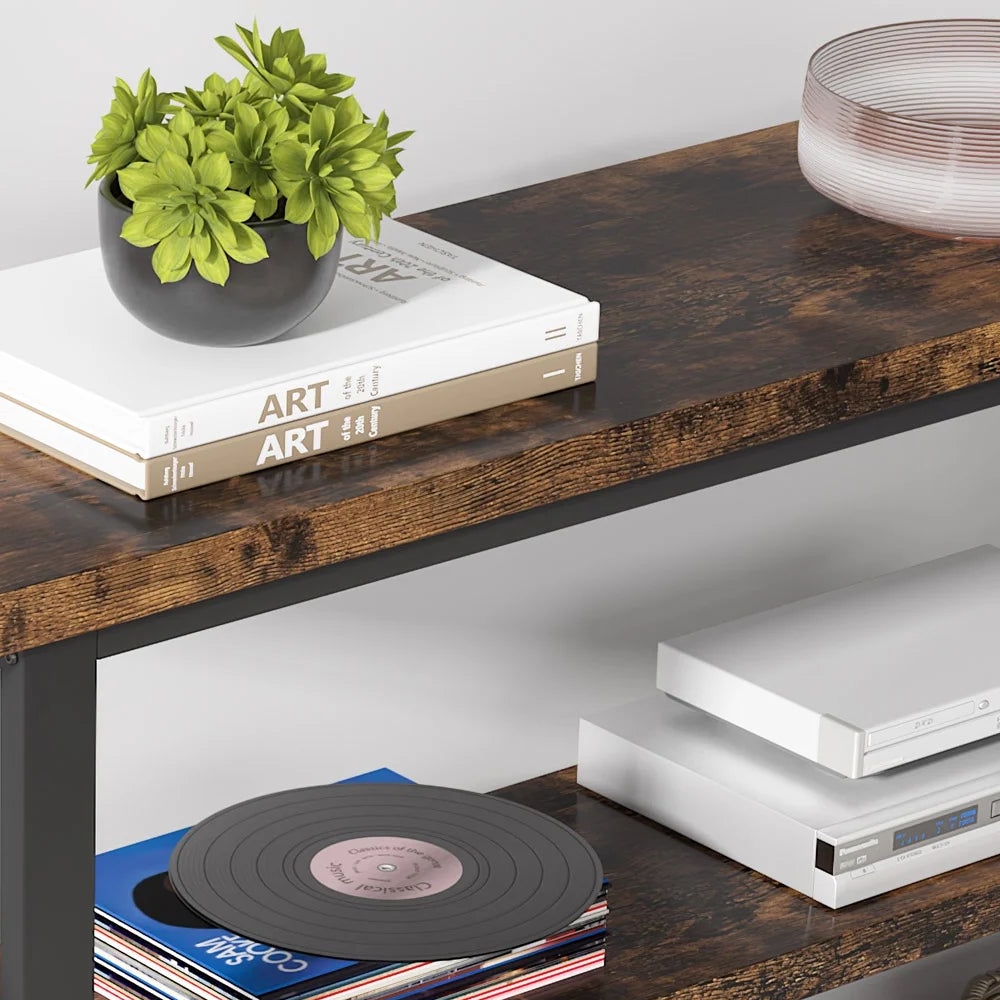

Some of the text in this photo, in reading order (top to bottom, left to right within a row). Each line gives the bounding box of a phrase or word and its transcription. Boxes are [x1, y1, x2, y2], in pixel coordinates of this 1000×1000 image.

[258, 380, 329, 424] ART
[256, 420, 329, 466] ART
[326, 862, 354, 885] music
[355, 881, 432, 894] Classical
[195, 937, 254, 966] SAM
